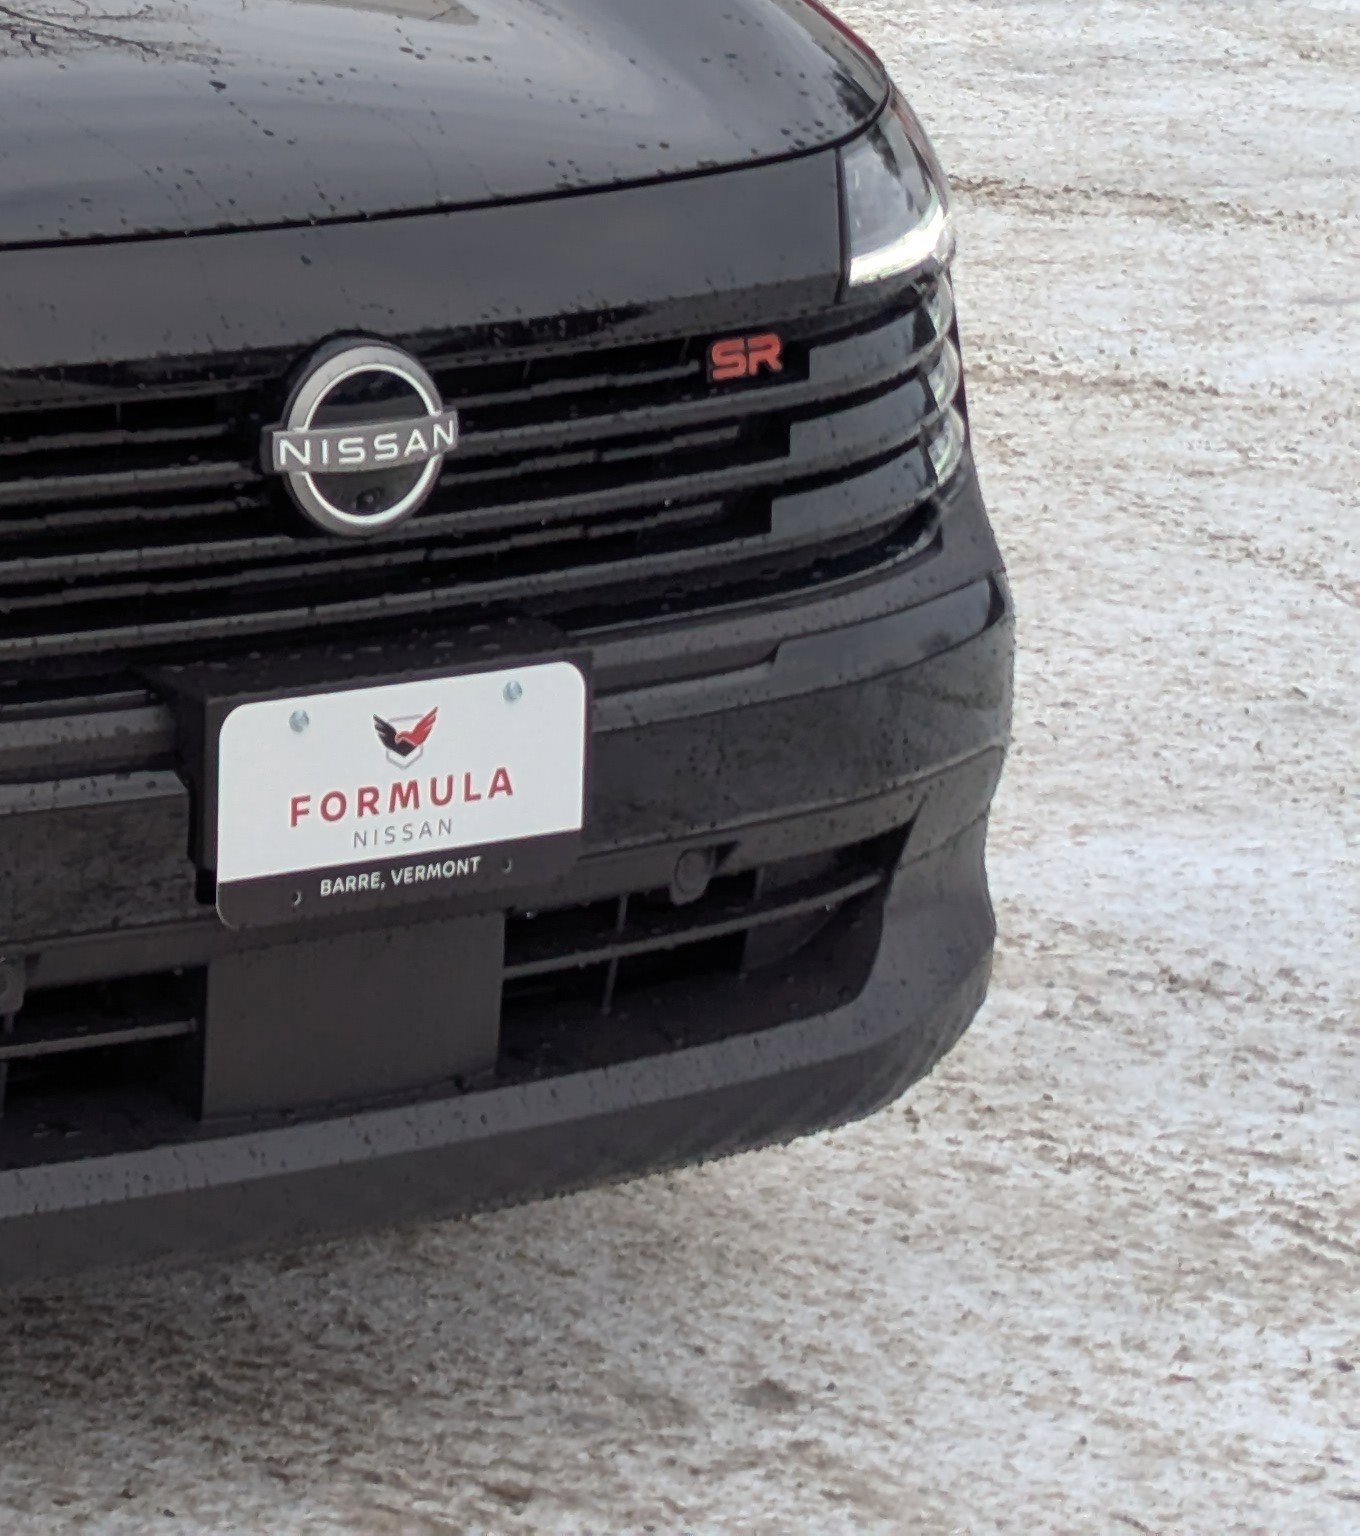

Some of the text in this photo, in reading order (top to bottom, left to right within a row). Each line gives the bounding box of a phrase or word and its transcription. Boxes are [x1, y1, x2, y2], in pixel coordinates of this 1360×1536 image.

[711, 333, 783, 380] SR
[279, 419, 455, 466] NISSAN
[289, 767, 514, 827] FORMULA
[353, 818, 453, 849] NISSAN
[320, 856, 483, 897] BARRE, VERMONT
